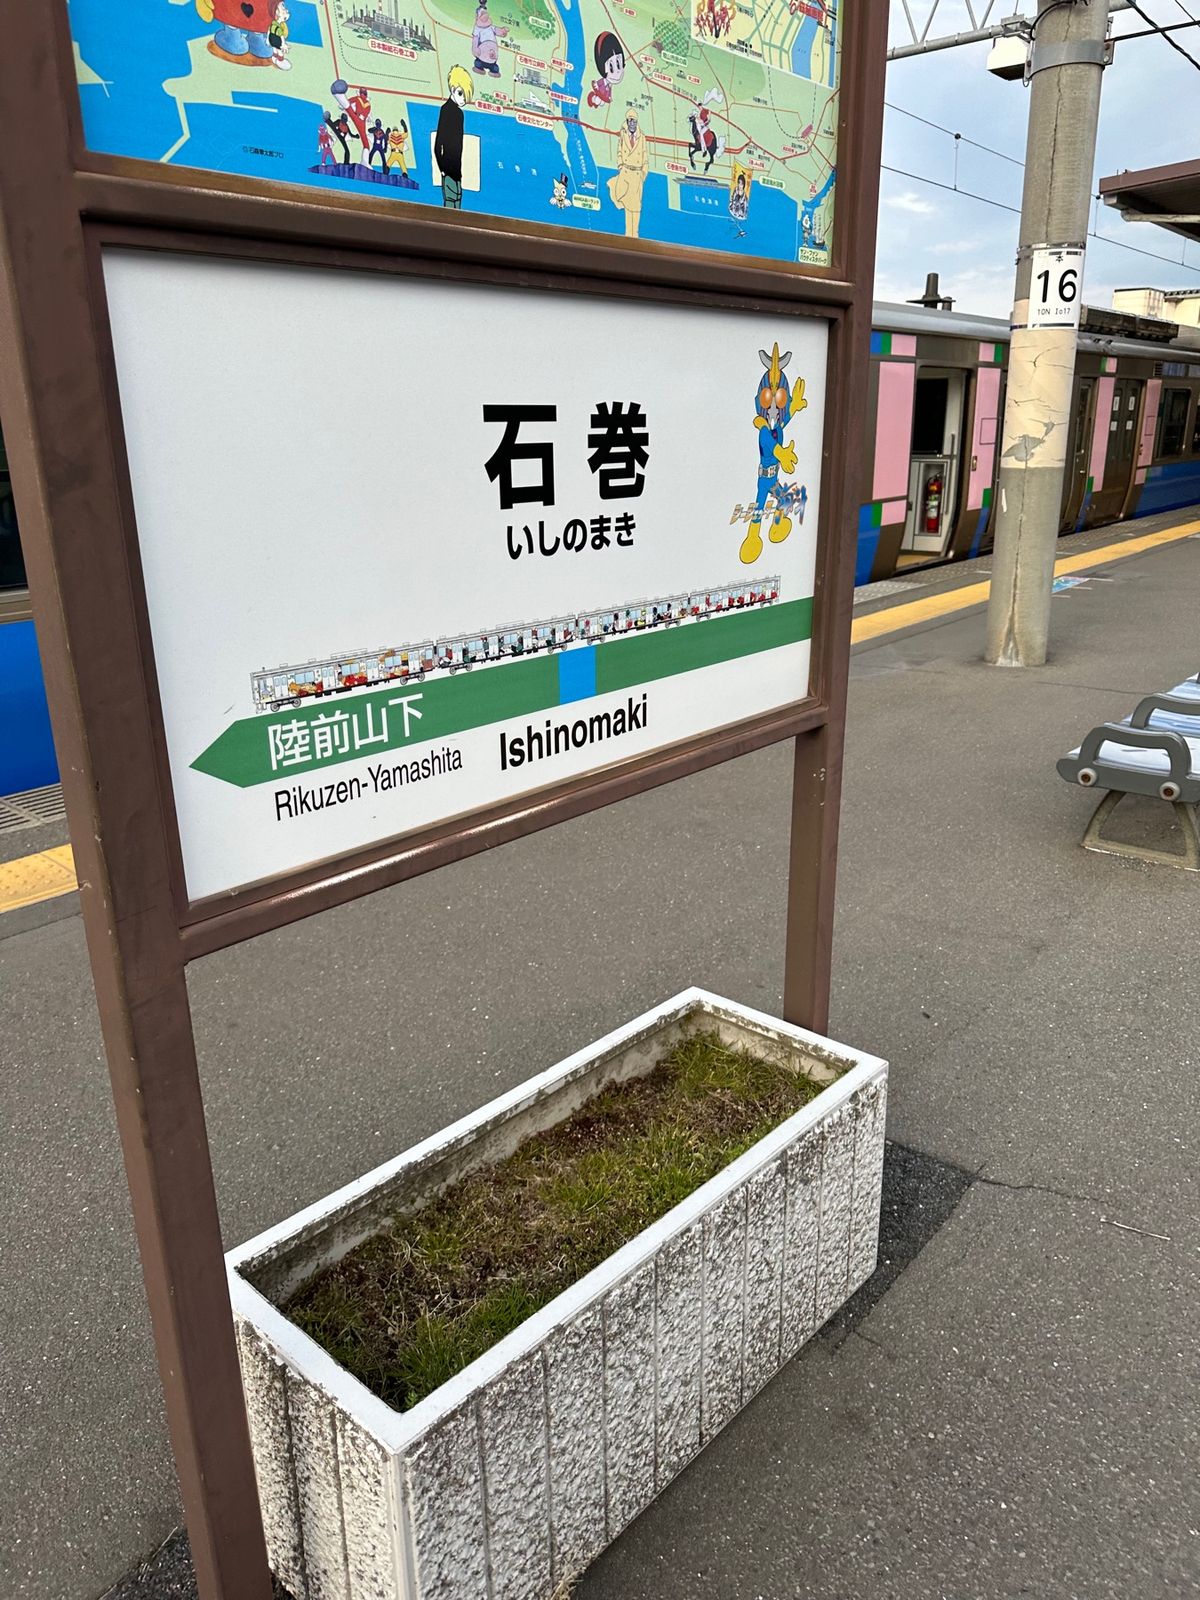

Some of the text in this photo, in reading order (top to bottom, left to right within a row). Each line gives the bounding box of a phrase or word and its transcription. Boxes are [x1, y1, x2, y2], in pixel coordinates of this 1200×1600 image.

[1037, 269, 1078, 303] 16
[483, 401, 650, 510] 石巻
[507, 512, 636, 560] いしのまき
[267, 693, 425, 771] 陸前山下
[499, 693, 648, 771] Ishinomaki
[275, 746, 463, 821] Rikuzen-Yamashita
